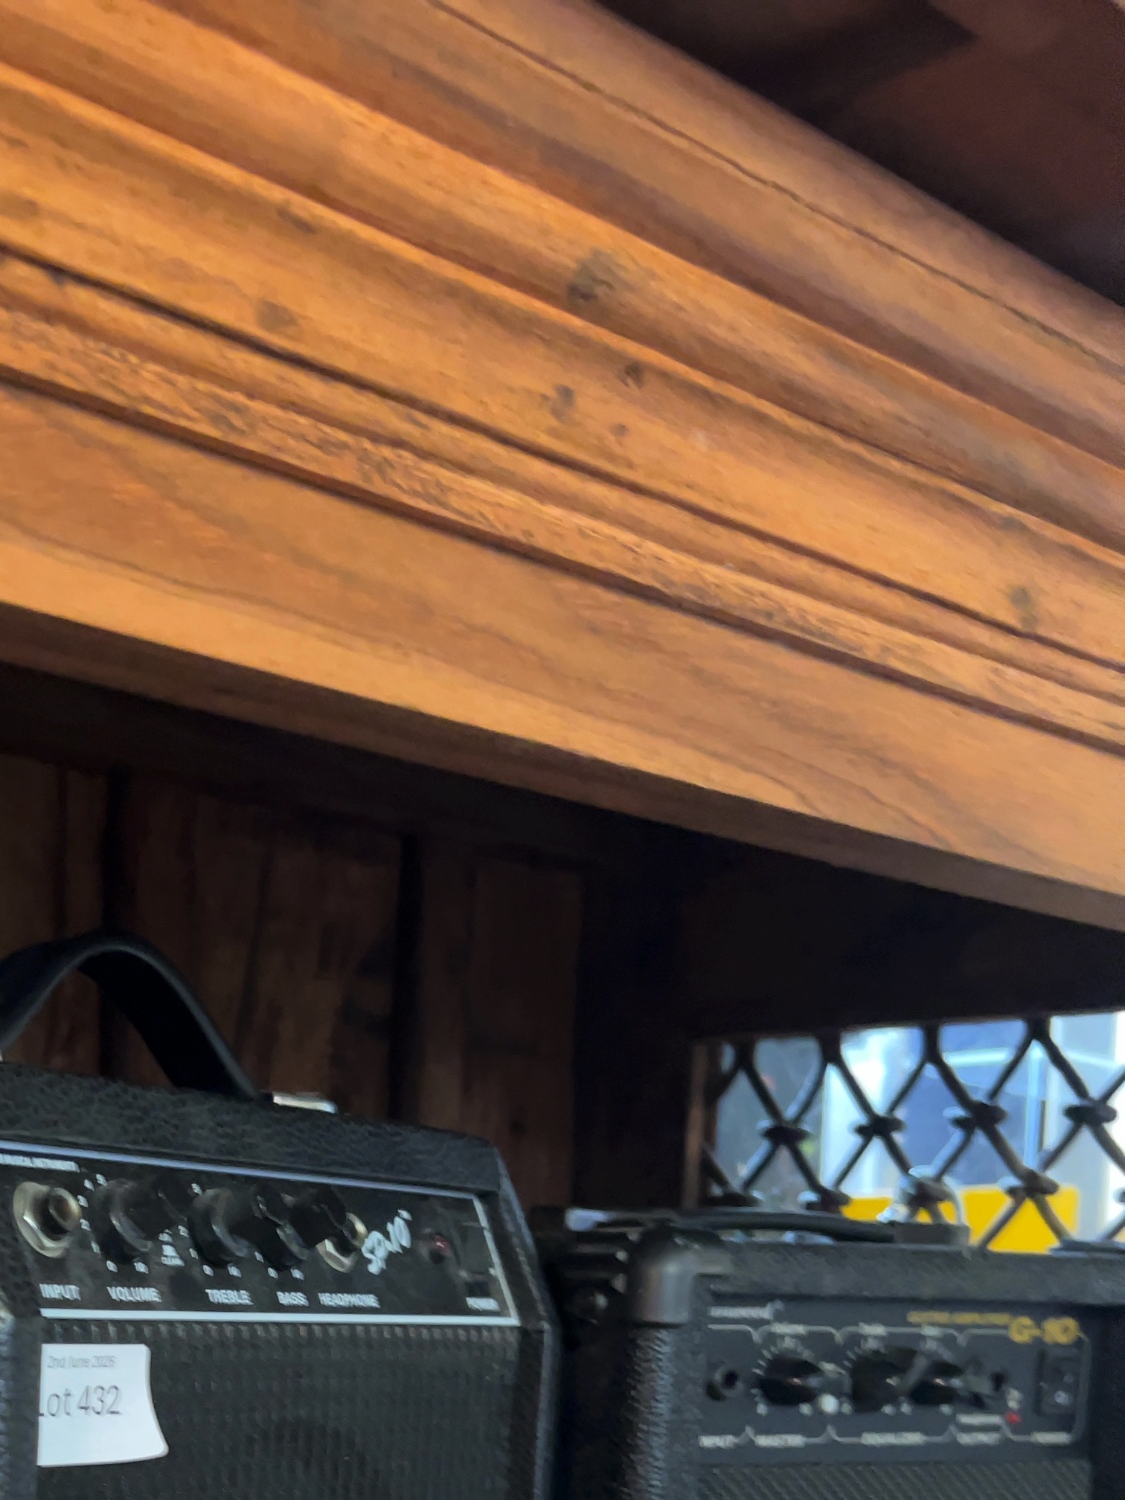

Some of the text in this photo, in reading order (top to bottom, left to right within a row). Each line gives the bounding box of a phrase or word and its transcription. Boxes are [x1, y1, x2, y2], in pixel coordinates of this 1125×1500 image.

[39, 1284, 81, 1301] INPUT
[106, 1286, 162, 1302] VOLUME
[205, 1289, 254, 1305] TREBLE
[276, 1291, 309, 1307] BASS
[77, 1385, 122, 1417] 432
